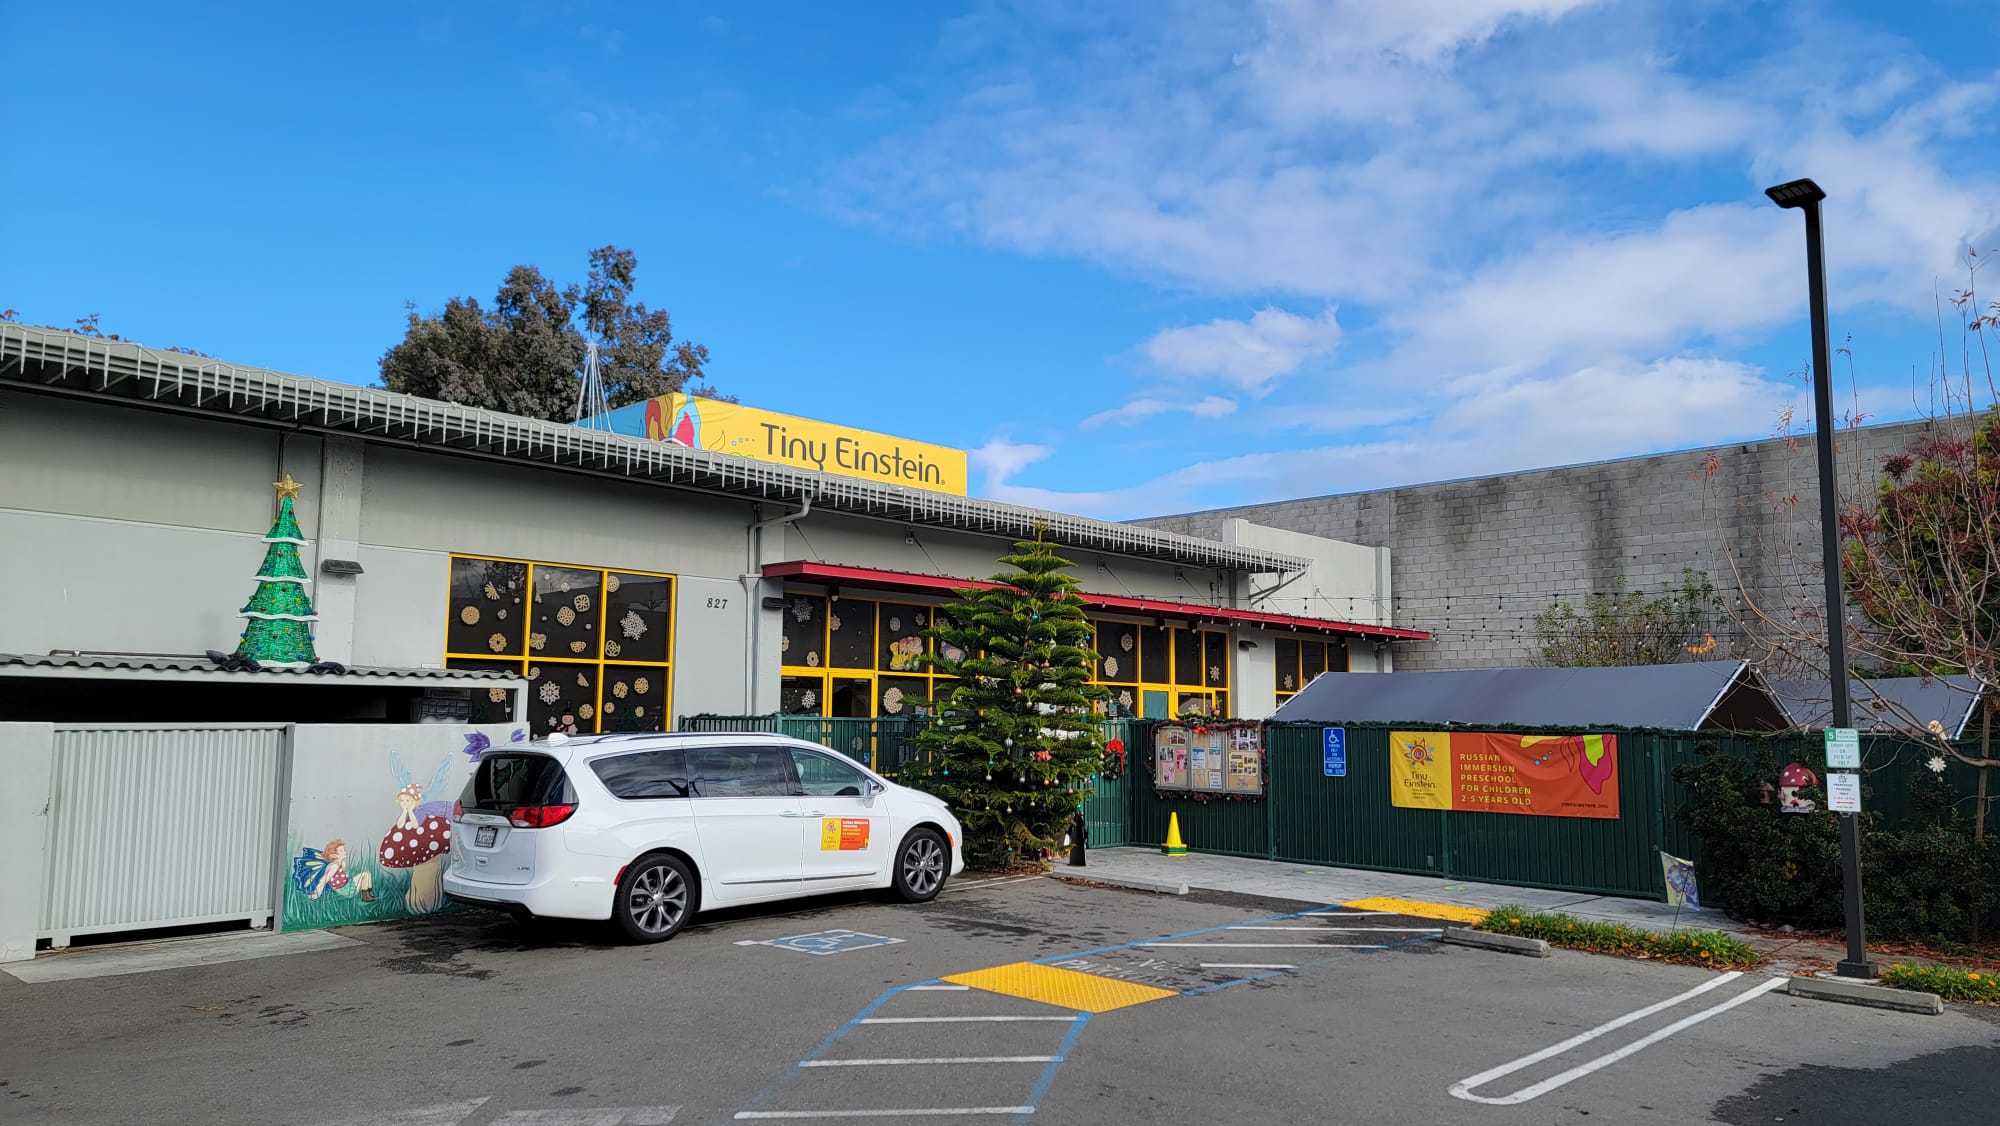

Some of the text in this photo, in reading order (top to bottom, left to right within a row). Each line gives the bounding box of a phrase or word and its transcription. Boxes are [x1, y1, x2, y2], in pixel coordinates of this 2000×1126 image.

[760, 422, 940, 485] Tiny Einstein
[706, 597, 728, 609] 827
[1828, 731, 1834, 740] 5
[1459, 753, 1500, 762] RUSSIAN
[1460, 763, 1515, 773] IMMERSION
[1411, 771, 1428, 780] Tiny
[1460, 773, 1517, 784] PRESCHOOL
[1461, 784, 1531, 795] FOR CHILDREN
[1461, 794, 1531, 806] 2-5 YEARS OLD
